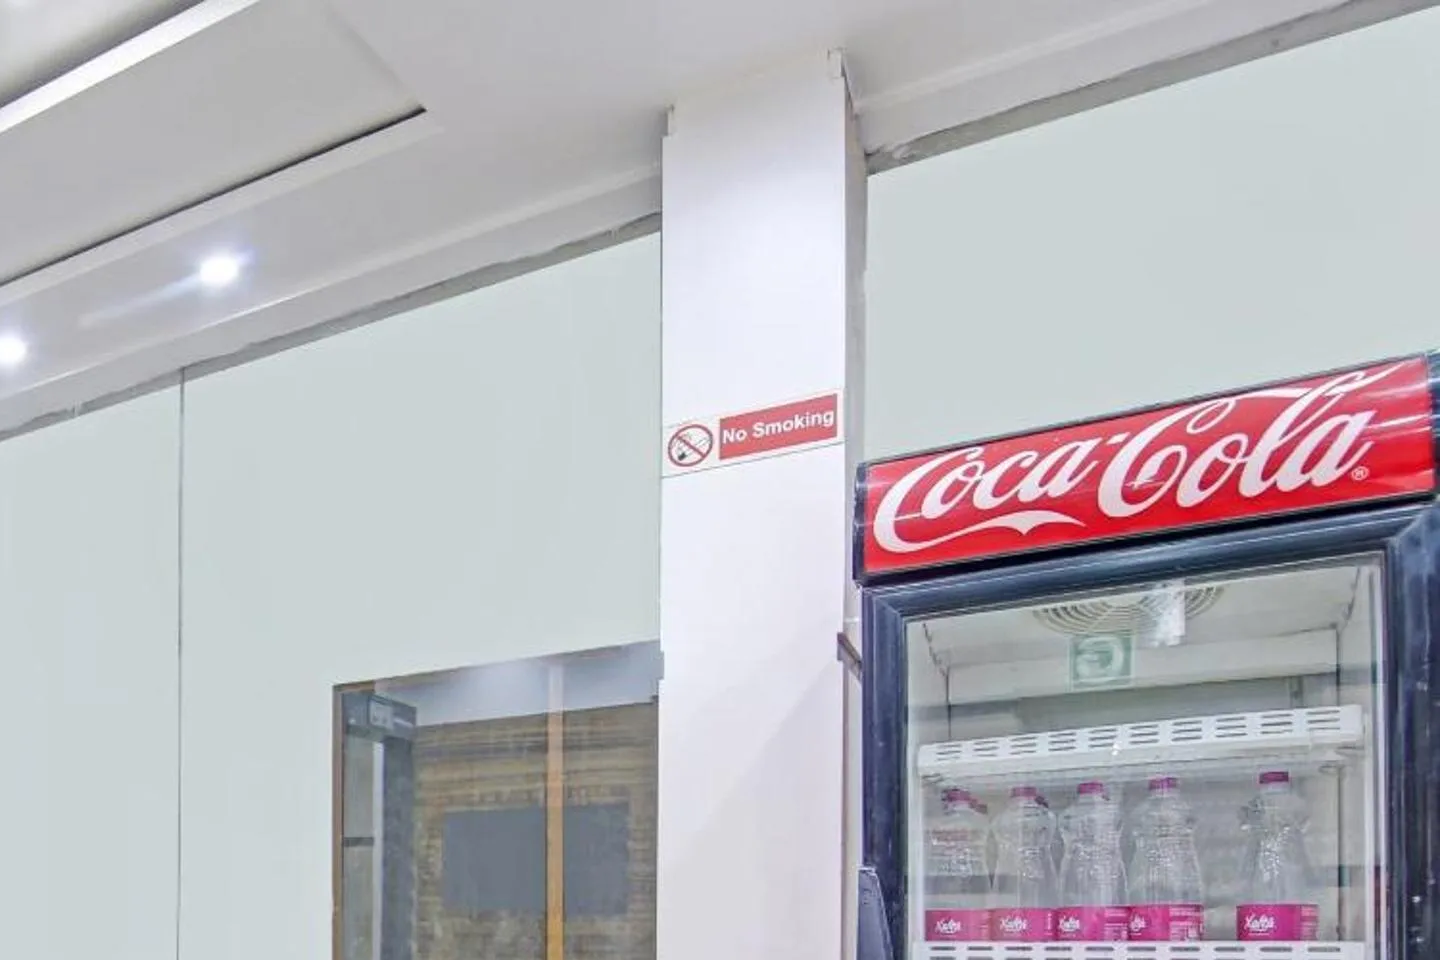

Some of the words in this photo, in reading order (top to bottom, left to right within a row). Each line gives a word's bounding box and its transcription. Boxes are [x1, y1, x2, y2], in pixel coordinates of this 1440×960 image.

[721, 427, 748, 444] No
[752, 410, 835, 440] Smoking
[872, 362, 1405, 553] Coca-Cola
